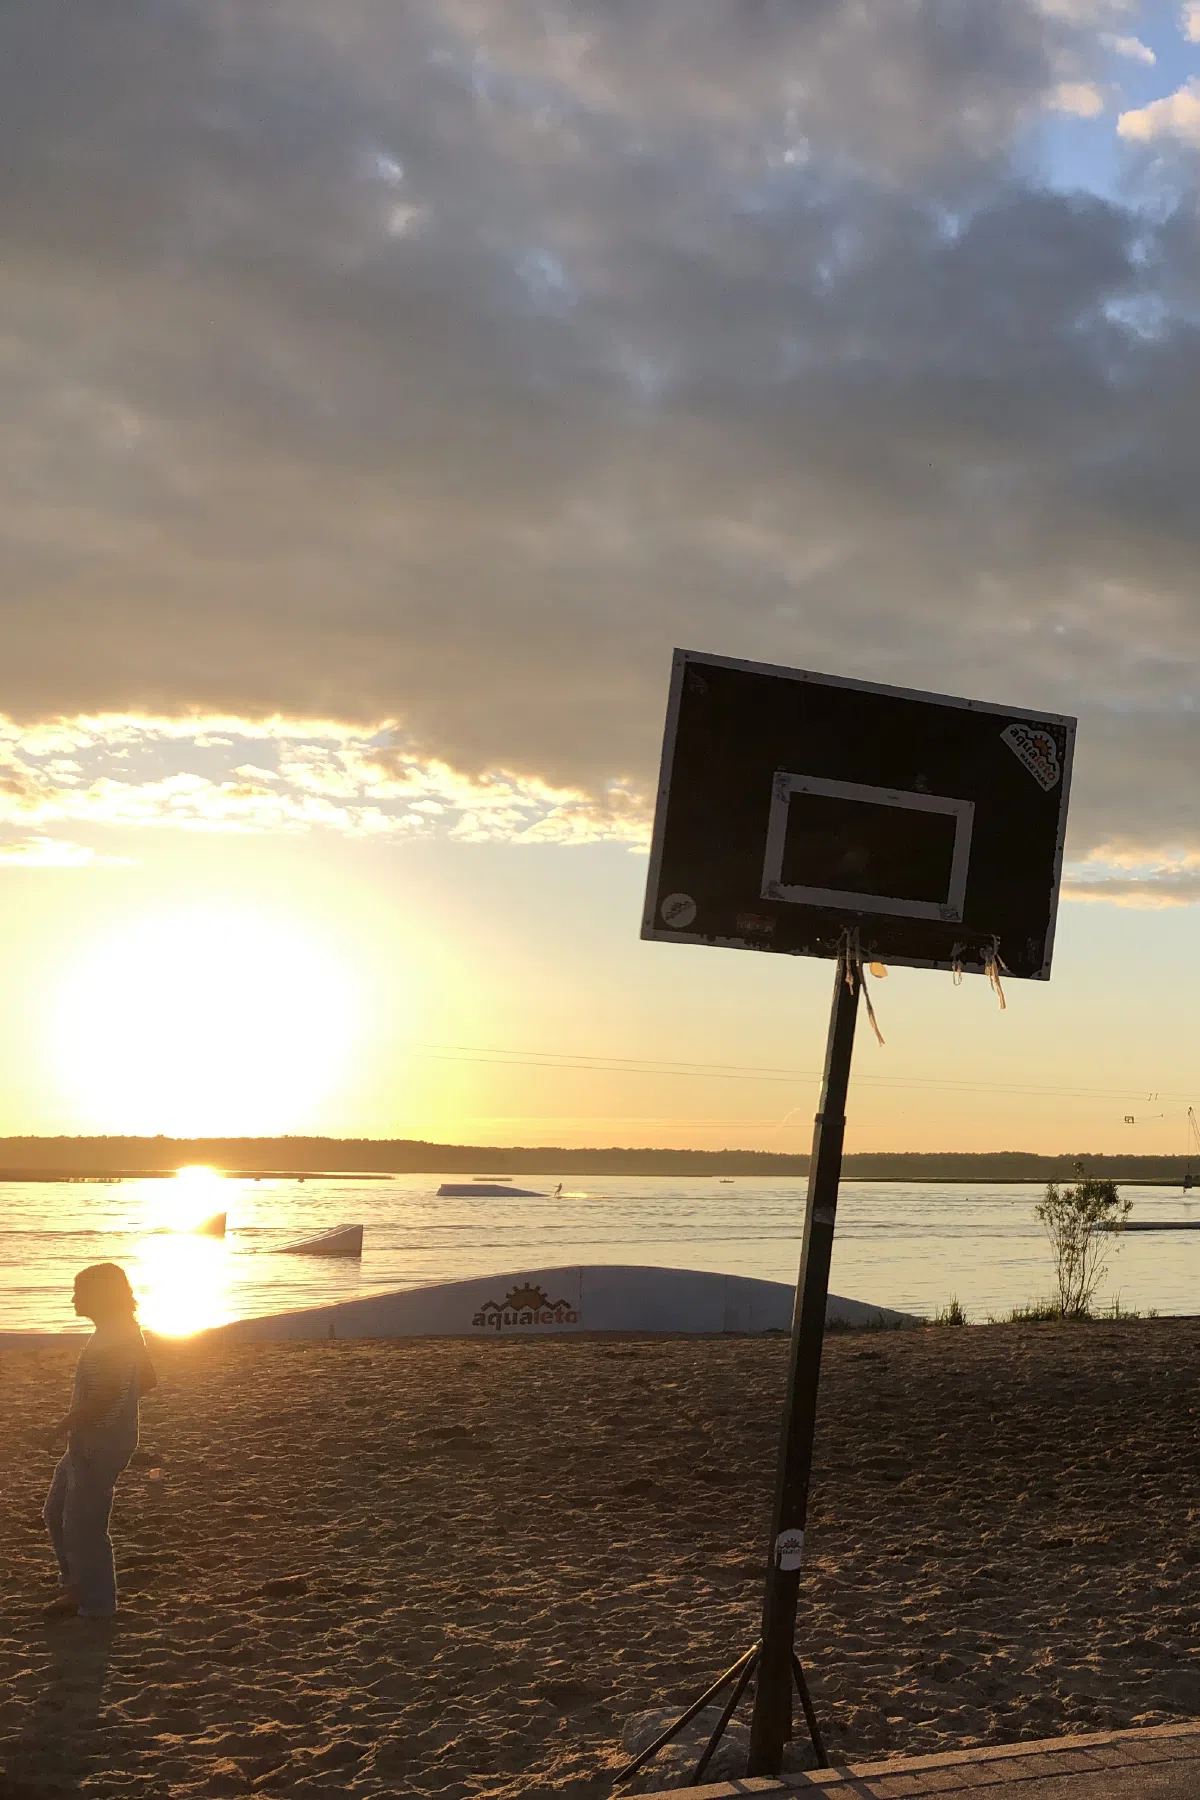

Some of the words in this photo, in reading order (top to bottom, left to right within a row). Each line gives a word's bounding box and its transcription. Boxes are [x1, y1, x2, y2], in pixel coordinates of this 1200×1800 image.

[1019, 752, 1036, 771] WAKE
[1033, 769, 1049, 787] PARK
[472, 1308, 578, 1330] aqualeto
